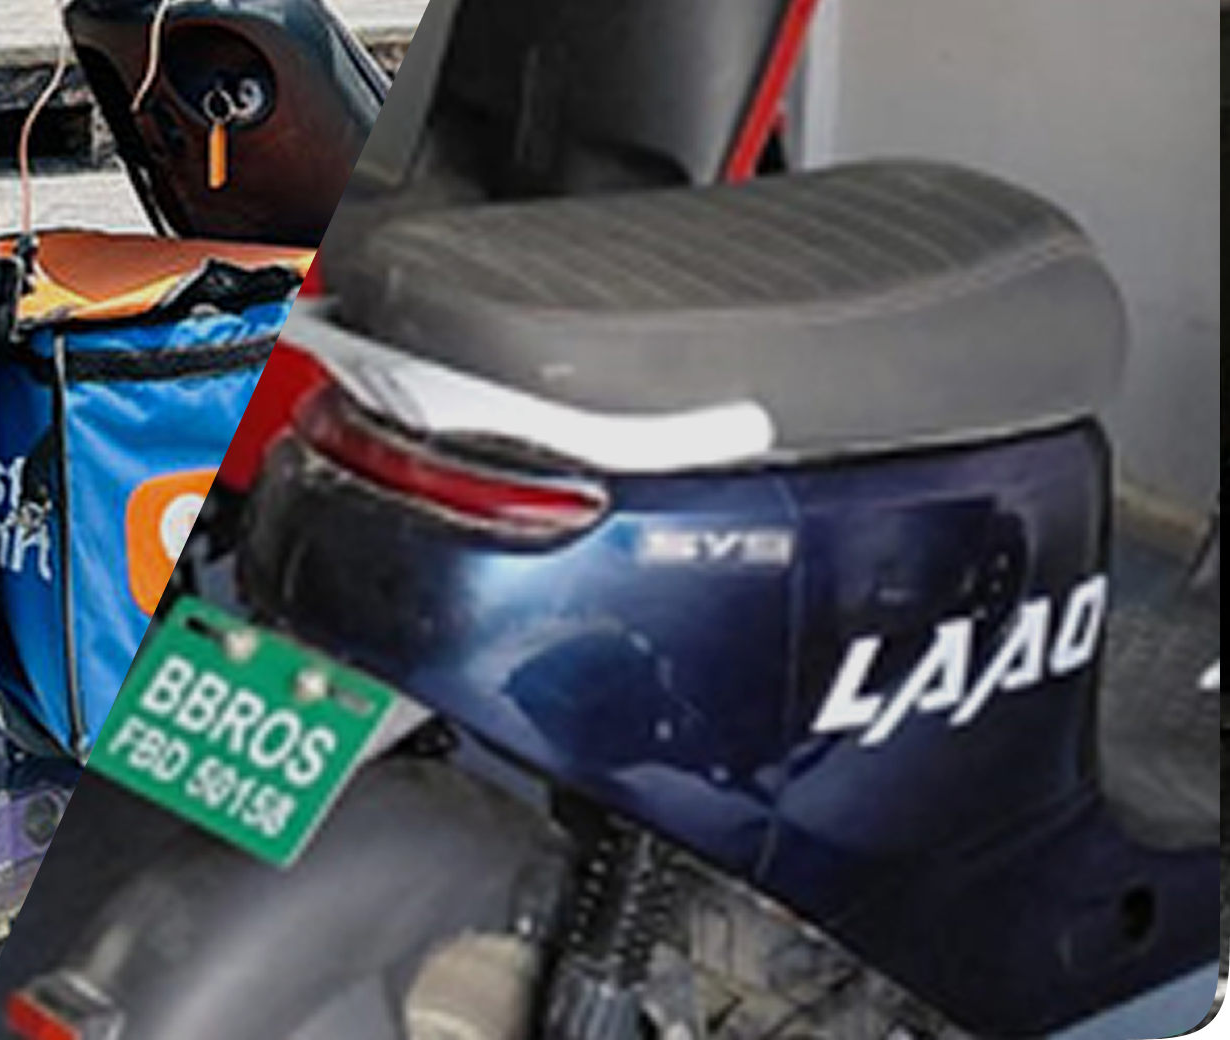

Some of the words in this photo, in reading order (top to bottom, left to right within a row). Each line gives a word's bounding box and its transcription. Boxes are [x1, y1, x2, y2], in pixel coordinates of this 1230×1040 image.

[140, 655, 336, 786] BBROS
[809, 572, 1107, 746] LAAO
[108, 715, 191, 782] FBD
